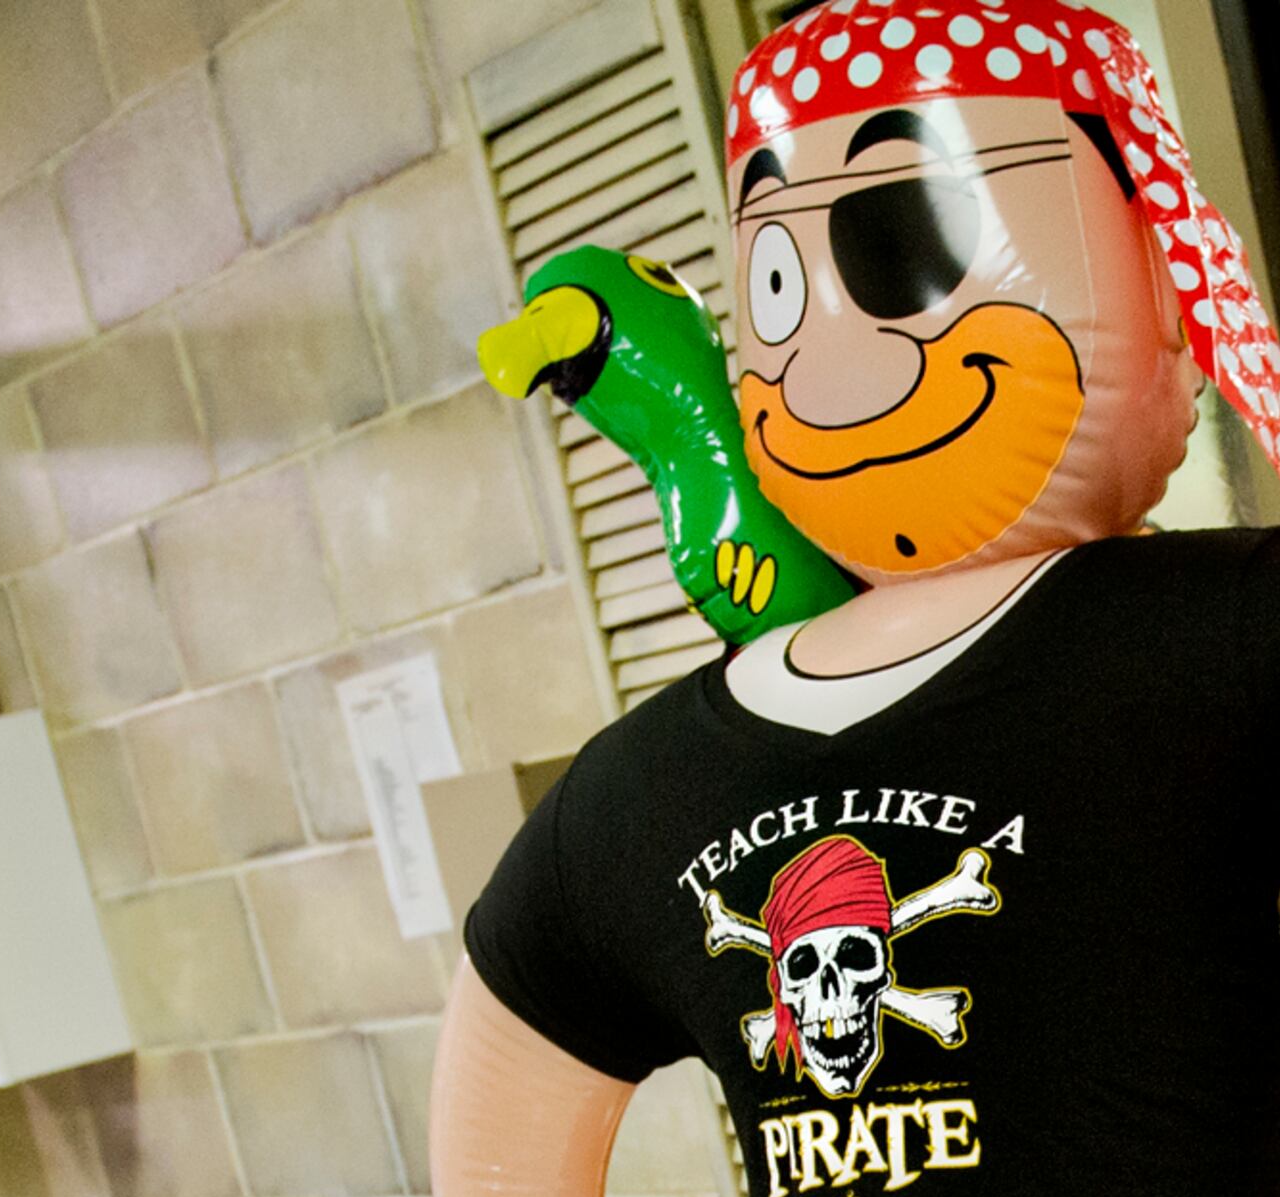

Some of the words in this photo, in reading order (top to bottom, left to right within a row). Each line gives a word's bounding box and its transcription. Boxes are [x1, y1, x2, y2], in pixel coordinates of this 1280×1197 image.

[677, 795, 819, 908] TEACH
[834, 788, 976, 834] LIKE
[980, 815, 1026, 854] A
